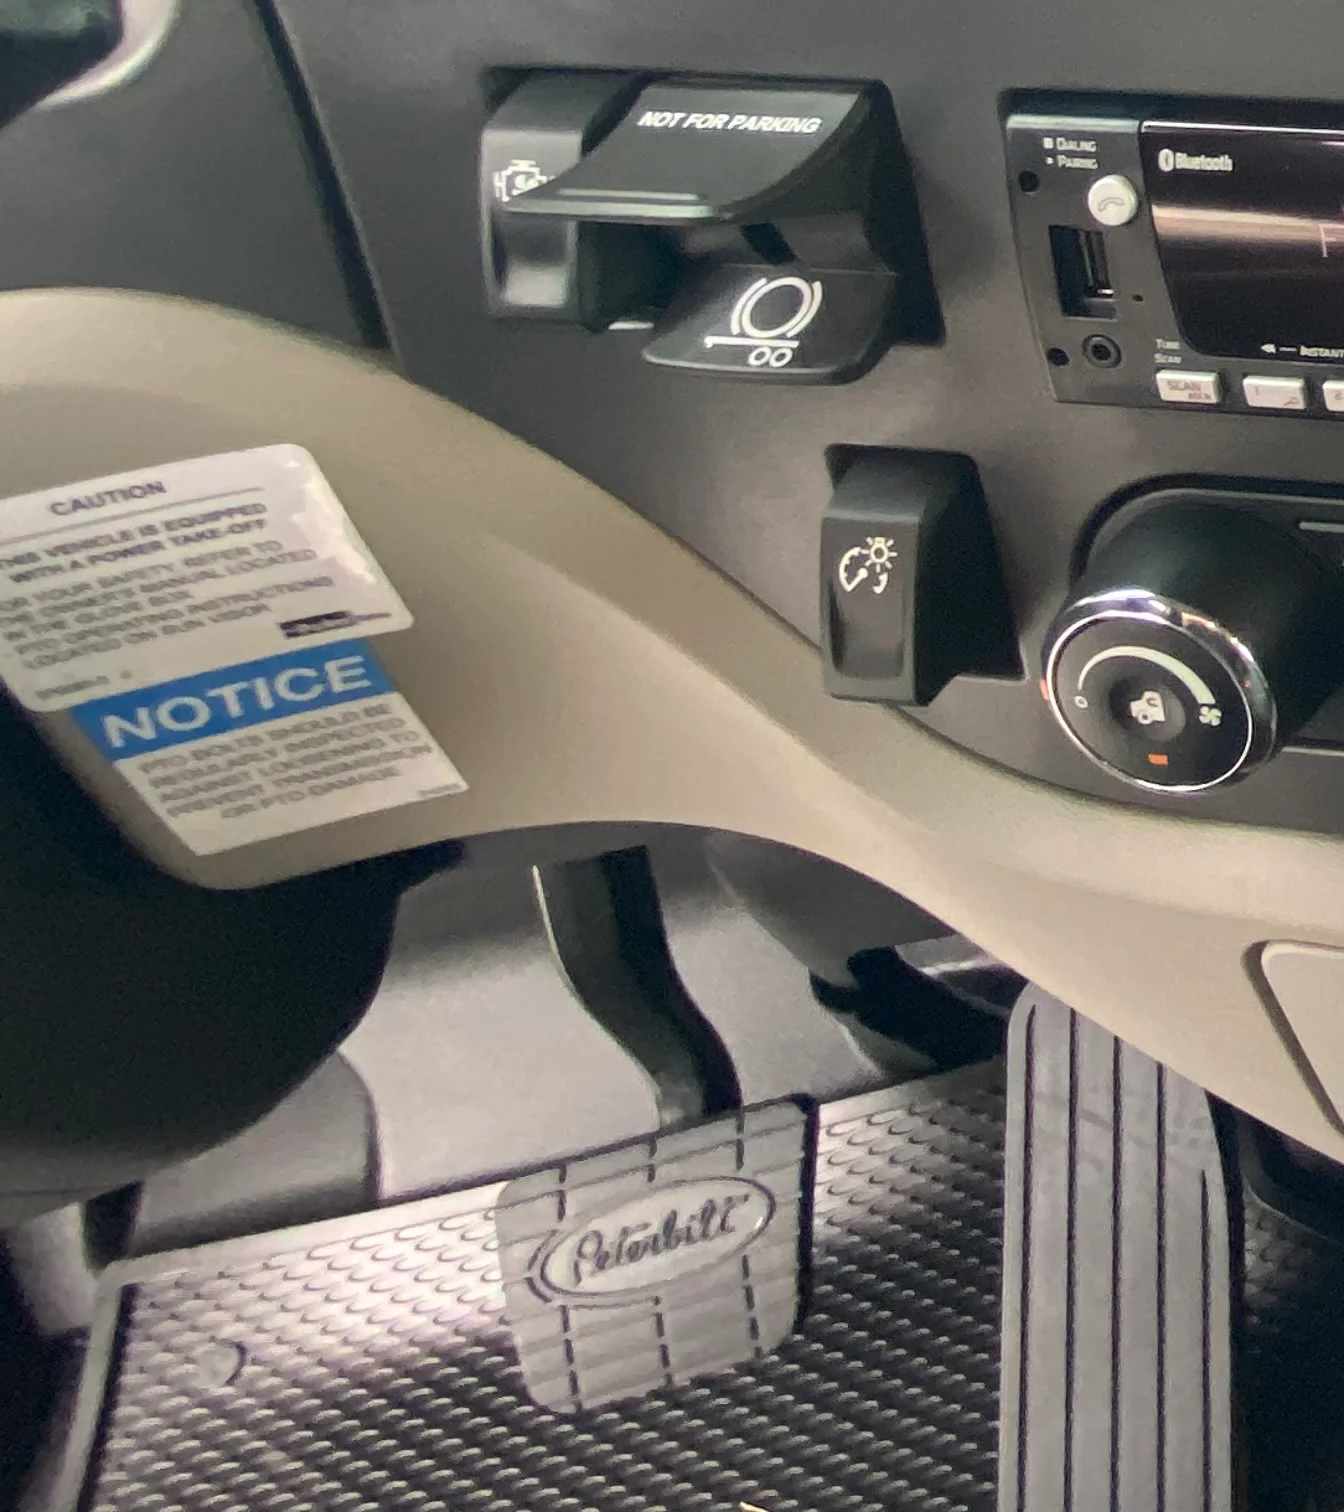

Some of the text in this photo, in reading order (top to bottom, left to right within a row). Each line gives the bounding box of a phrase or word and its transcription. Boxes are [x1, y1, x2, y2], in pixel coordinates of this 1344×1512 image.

[637, 111, 823, 133] NOT FOR PARKING
[1175, 152, 1234, 172] Bluetooth
[49, 481, 168, 516] CAUTION
[102, 655, 372, 749] NOTICE
[572, 1193, 751, 1288] Peterbilt
